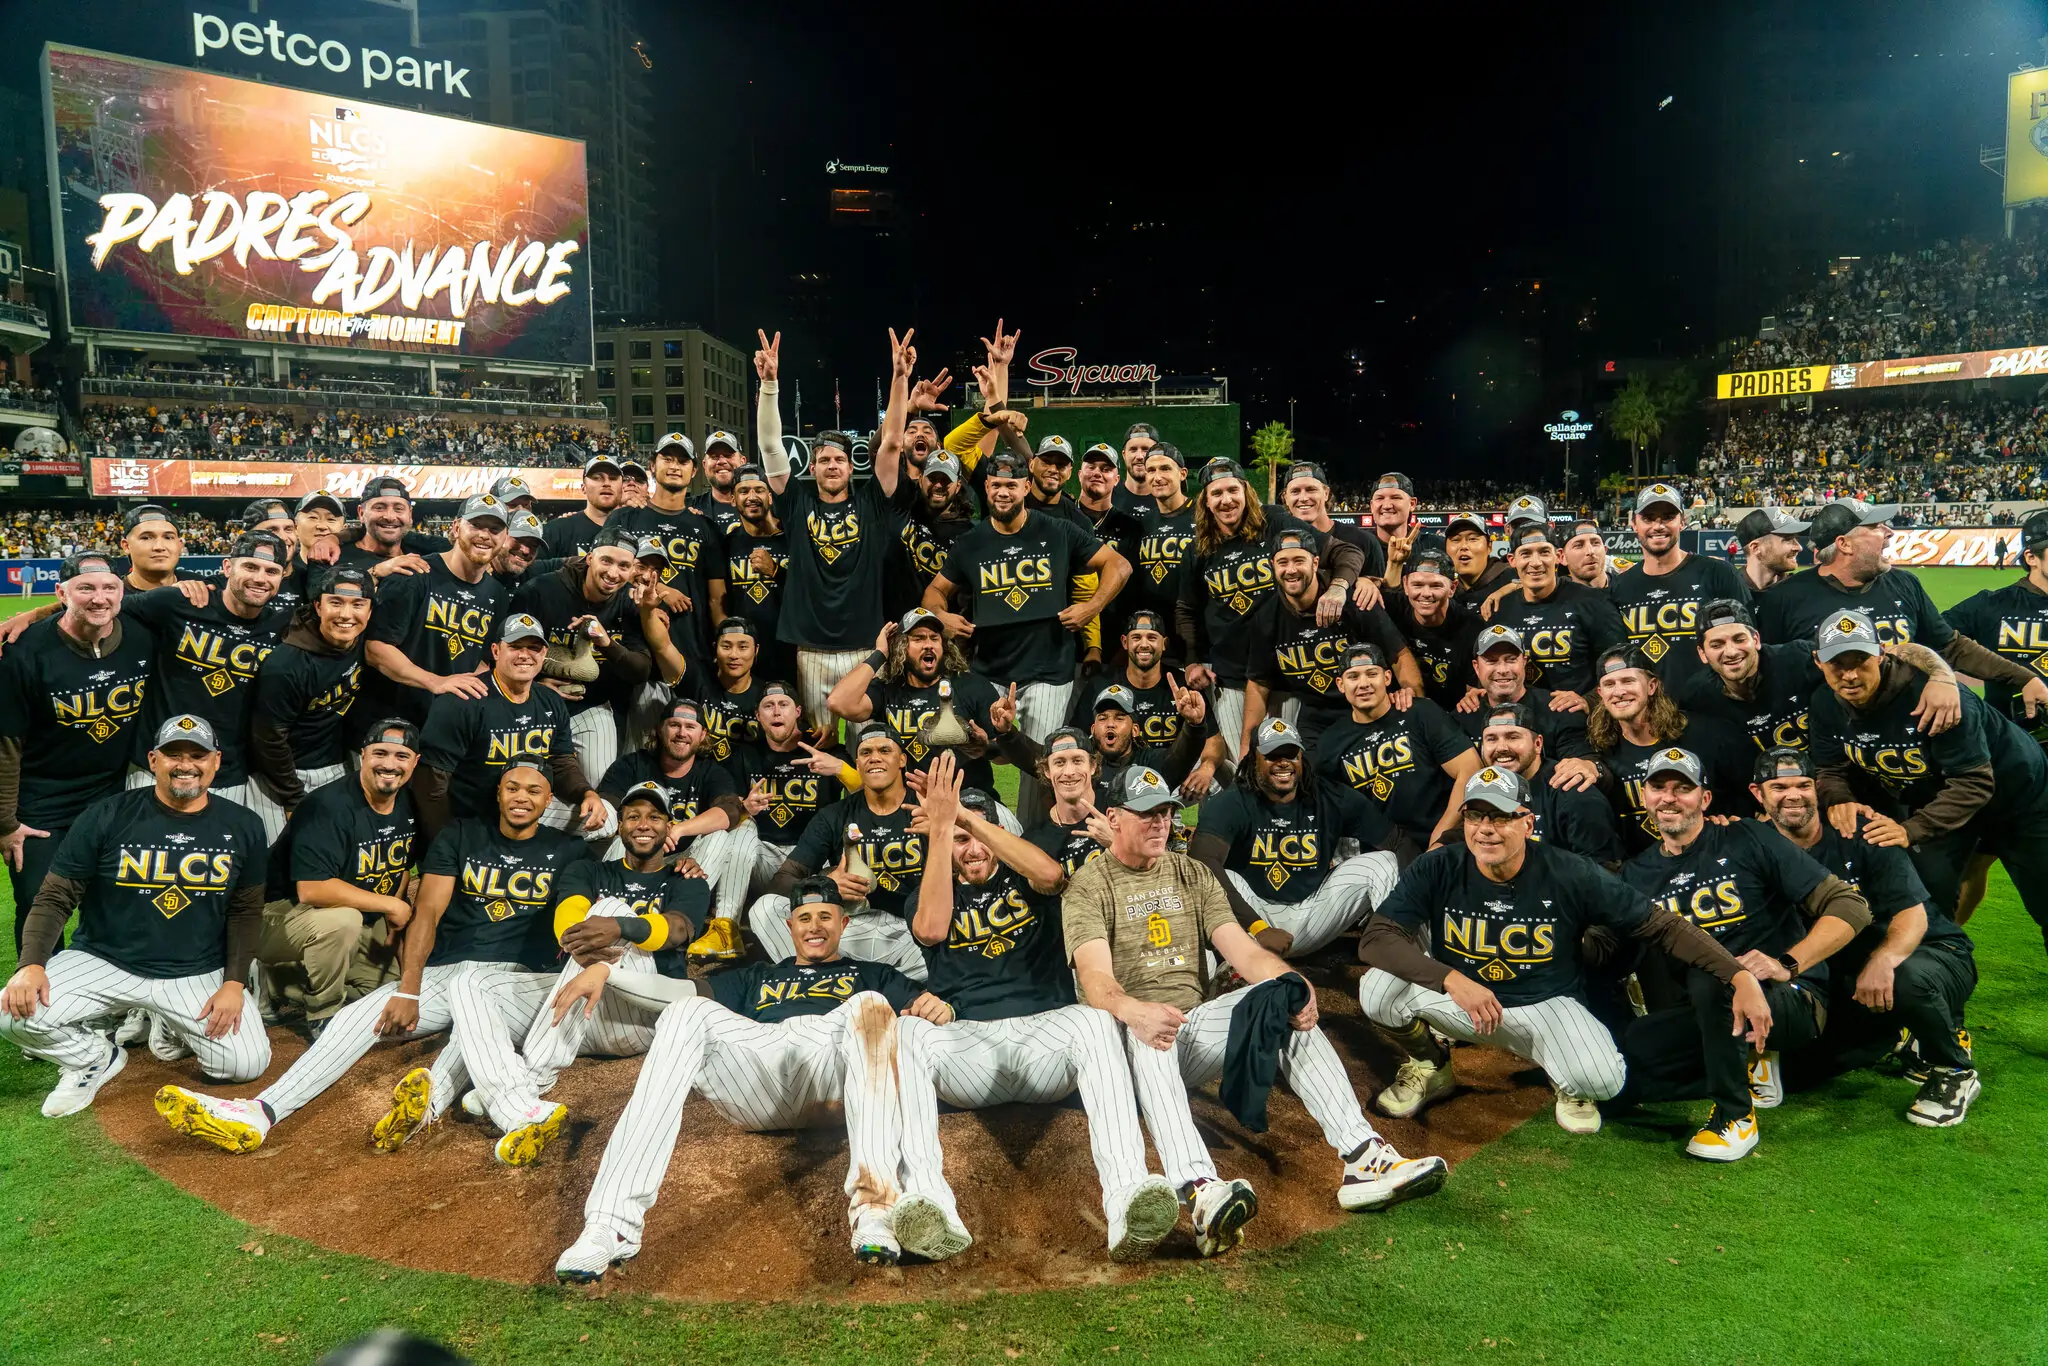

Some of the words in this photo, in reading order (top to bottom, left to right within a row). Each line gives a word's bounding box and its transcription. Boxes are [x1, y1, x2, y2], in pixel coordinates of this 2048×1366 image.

[193, 12, 351, 73] petco
[362, 47, 471, 98] park
[840, 163, 865, 173] Sempra
[866, 164, 889, 174] Energy
[86, 190, 372, 276] PADRES
[312, 240, 581, 317] ADVANCE
[246, 303, 354, 337] CAPTURE
[368, 313, 465, 346] MOMENT
[1026, 346, 1161, 395] Sycuan
[1730, 368, 1813, 397] PADRES
[1543, 422, 1593, 434] Gallagher
[1550, 431, 1586, 442] Square
[110, 466, 149, 479] NLCS
[807, 509, 860, 543] NLCS
[1140, 538, 1193, 559] NLCS
[980, 559, 1052, 588] NLCS
[1204, 557, 1274, 595] NLCS
[425, 596, 492, 638] NLCS
[177, 625, 273, 674] NLCS
[53, 679, 146, 719] NLCS
[488, 727, 555, 760] NLCS
[1345, 736, 1412, 783] NLCS
[1251, 833, 1317, 860] NLCS
[117, 849, 233, 884] NLCS
[462, 862, 553, 899] NLCS
[1126, 896, 1182, 920] PADRES
[1127, 893, 1145, 903] SAN
[1147, 913, 1172, 948] SD
[1444, 912, 1554, 956] NLCS
